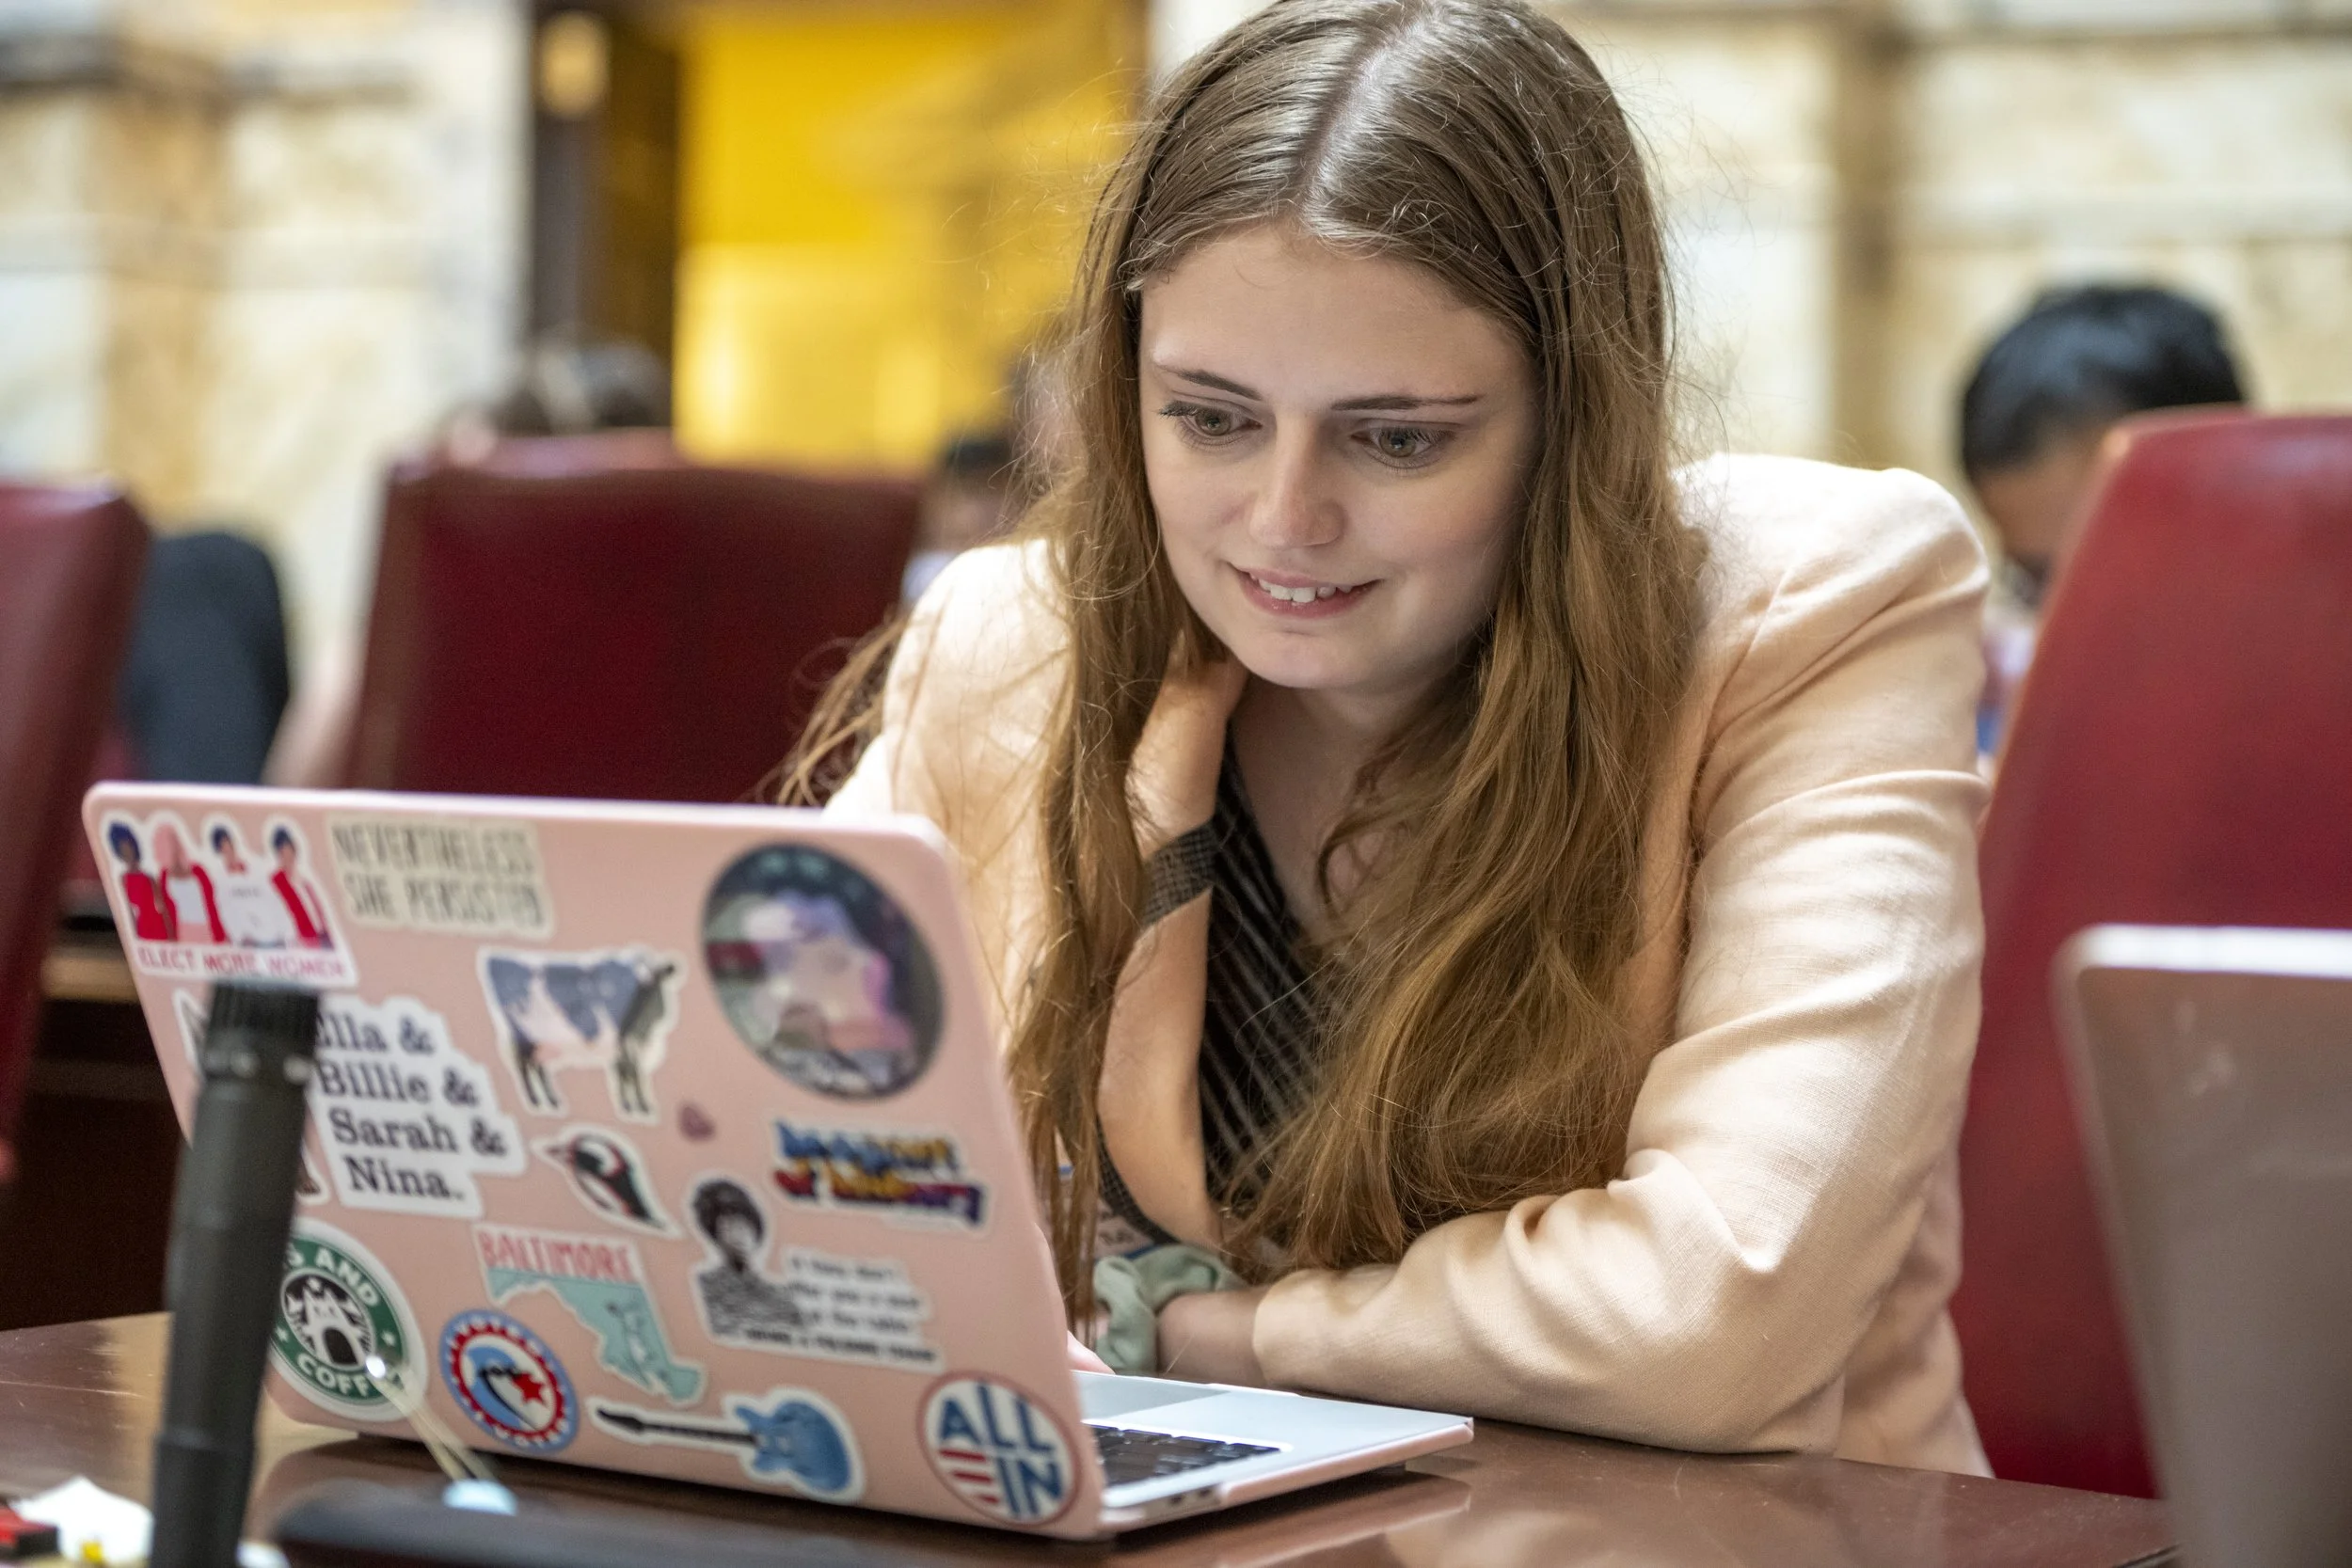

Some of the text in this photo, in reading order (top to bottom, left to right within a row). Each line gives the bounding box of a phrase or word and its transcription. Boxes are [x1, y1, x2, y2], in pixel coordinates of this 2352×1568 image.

[203, 952, 257, 973] MORE
[400, 1015, 434, 1054] &
[318, 1059, 480, 1109] Billie &
[329, 1107, 508, 1157] Sarah &
[343, 1153, 465, 1200] Nina.
[315, 1247, 379, 1307] AND
[477, 1231, 638, 1283] BALTIMORE
[938, 1380, 1057, 1451] ALL
[995, 1456, 1064, 1520] IN
